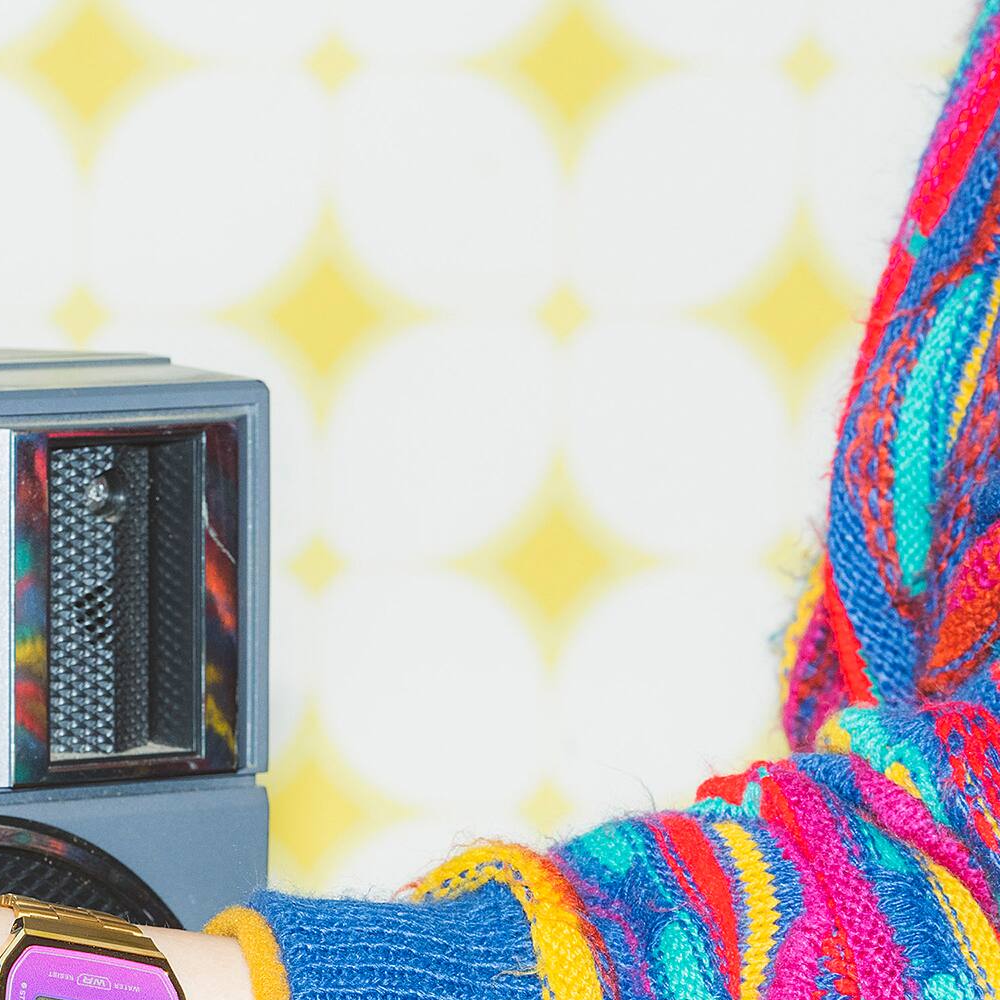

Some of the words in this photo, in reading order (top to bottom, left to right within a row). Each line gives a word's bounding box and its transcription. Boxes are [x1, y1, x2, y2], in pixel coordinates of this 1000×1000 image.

[48, 971, 75, 982] RESIST
[82, 975, 107, 988] WR
[114, 982, 142, 993] WATER
